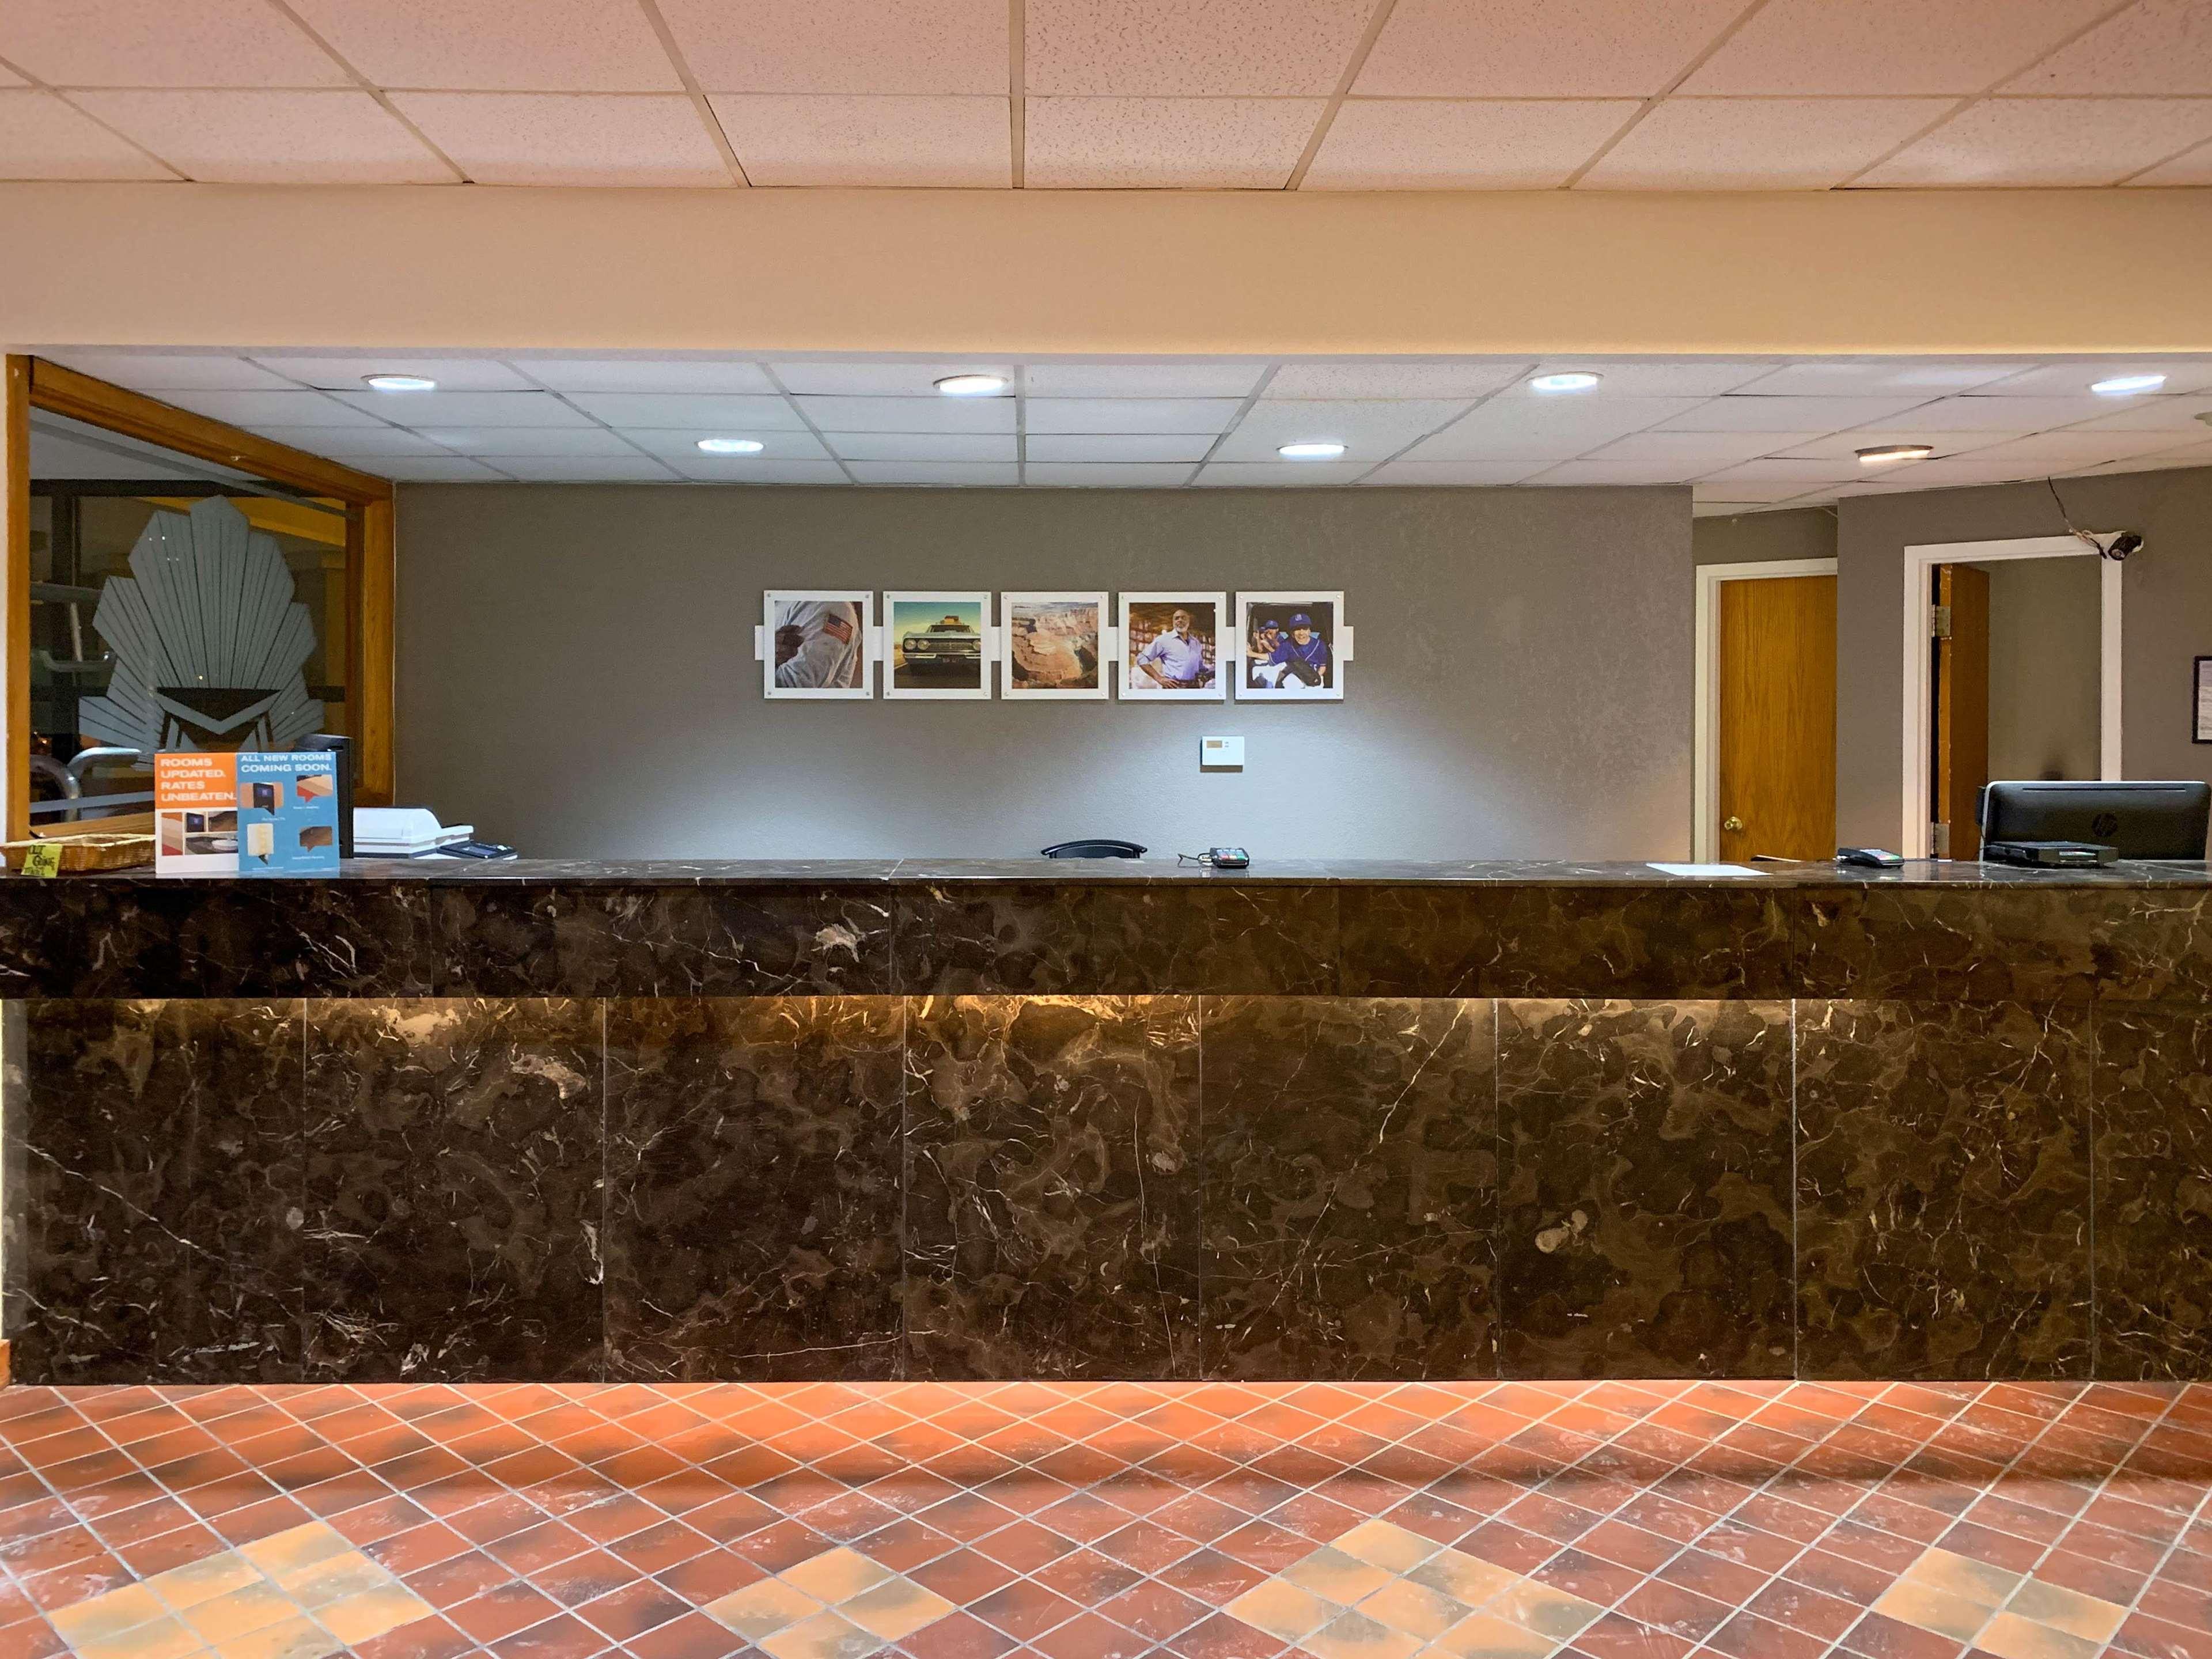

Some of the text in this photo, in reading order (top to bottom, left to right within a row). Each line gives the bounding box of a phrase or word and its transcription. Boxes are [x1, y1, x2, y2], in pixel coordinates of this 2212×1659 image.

[160, 758, 213, 767] ROOMS
[241, 763, 332, 772] COMING SOON.
[161, 769, 226, 779] UPDATED.
[160, 781, 205, 790] RATES
[161, 791, 237, 802] UNBEATEN.
